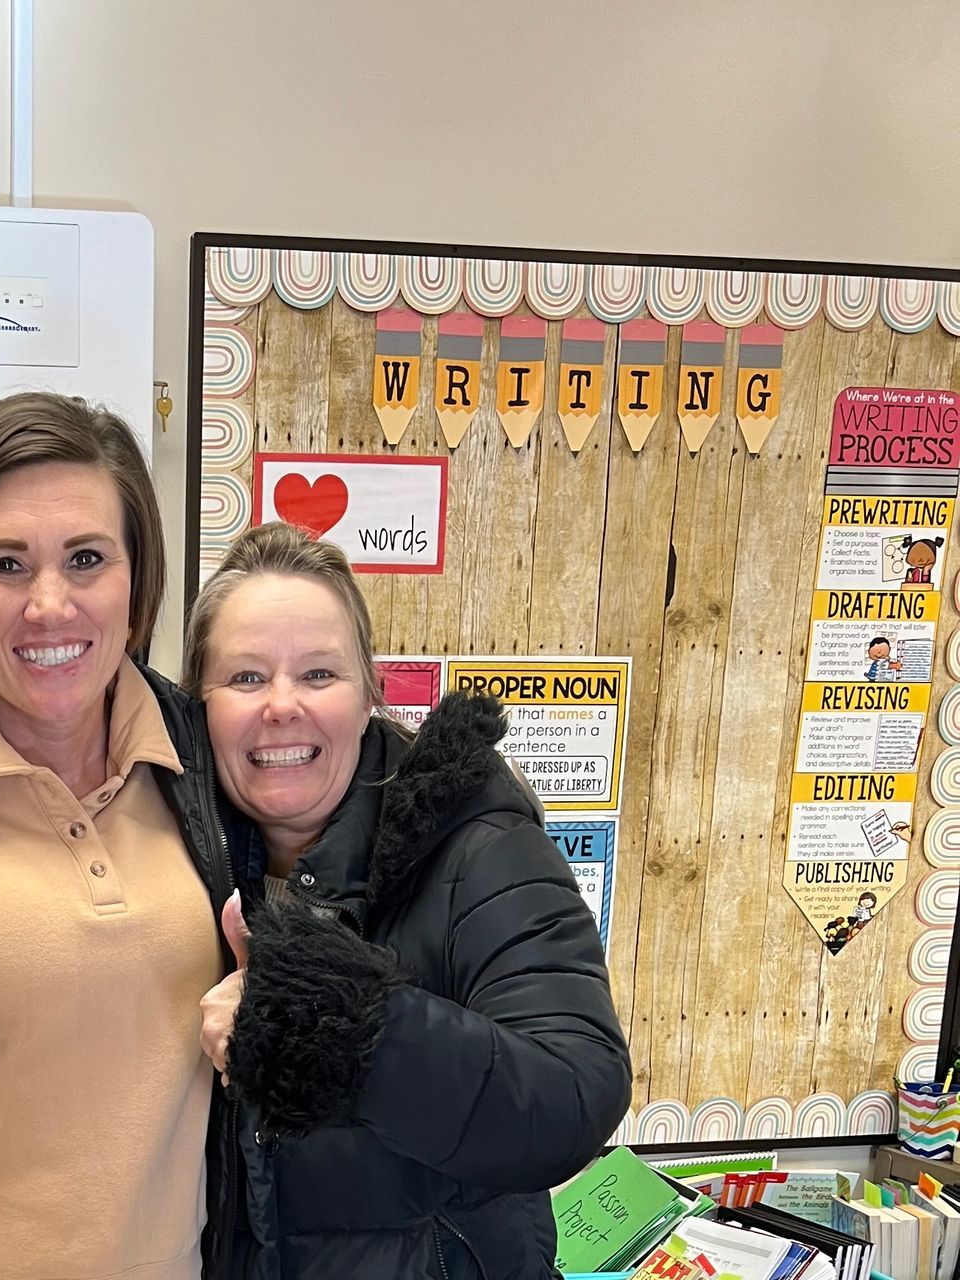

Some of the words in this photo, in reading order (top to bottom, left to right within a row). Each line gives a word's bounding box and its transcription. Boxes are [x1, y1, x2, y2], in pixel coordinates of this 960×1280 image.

[847, 390, 879, 402] Where
[883, 391, 911, 403] We're
[914, 393, 924, 403] at
[928, 395, 935, 404] in
[939, 394, 954, 405] the
[840, 404, 958, 434] WRITING
[837, 434, 953, 464] PROCESS
[829, 499, 947, 525] PREWRITING
[359, 514, 428, 555] words
[828, 592, 925, 619] DRAFTING
[458, 676, 546, 699] PROPER
[553, 677, 617, 699] NOUN
[821, 686, 909, 710] REVISING
[518, 708, 544, 720] that
[549, 710, 593, 720] names
[598, 710, 607, 720] a
[509, 726, 522, 736] or
[527, 726, 571, 738] person
[576, 724, 586, 736] in
[590, 727, 599, 736] a
[503, 742, 566, 752] sentence
[533, 761, 568, 773] DRESSED
[571, 762, 581, 772] UP
[585, 761, 595, 772] AS
[554, 780, 565, 790] OF
[567, 780, 603, 790] LIBERTY.
[813, 776, 894, 800] EDITING
[796, 862, 894, 884] PUBLISHING
[588, 1174, 629, 1225] Passion
[802, 1185, 833, 1193] Ballgame
[558, 1200, 612, 1245] Project
